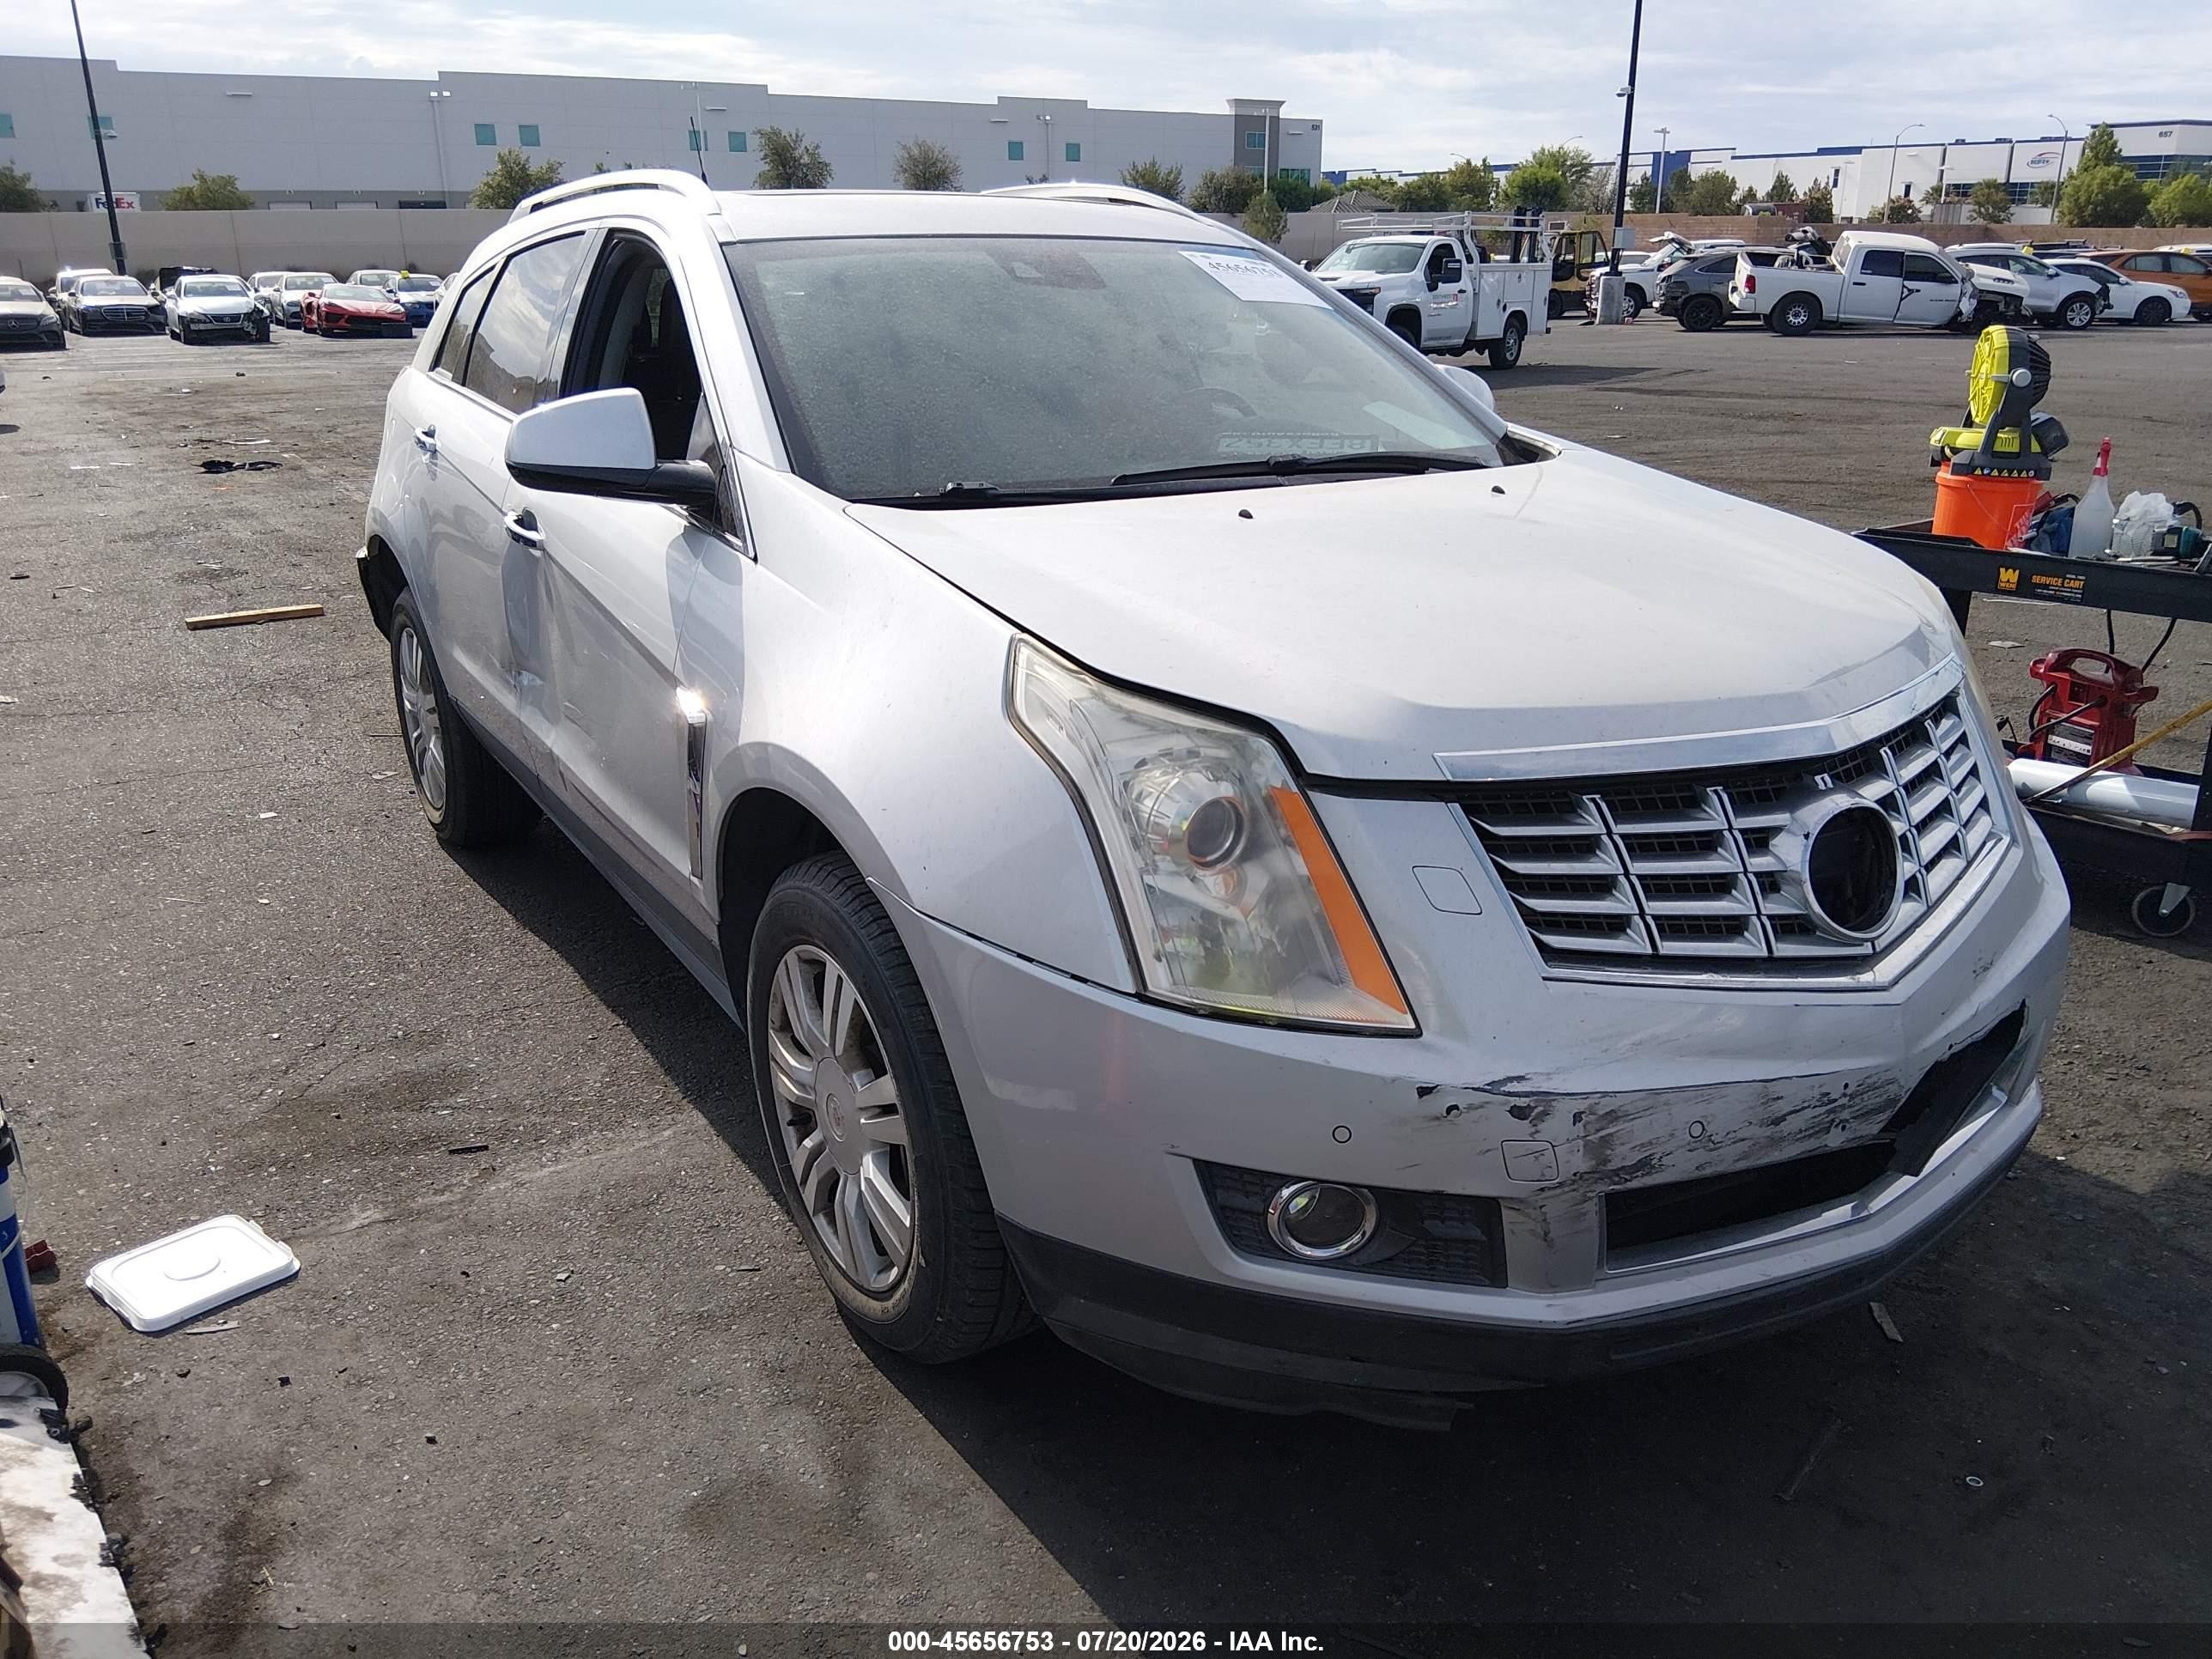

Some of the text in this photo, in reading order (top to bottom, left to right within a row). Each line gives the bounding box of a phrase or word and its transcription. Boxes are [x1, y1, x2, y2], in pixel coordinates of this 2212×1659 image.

[94, 198, 136, 210] FeEx
[1999, 581, 2017, 590] WEN
[2032, 574, 2063, 586] SERVICE
[2064, 578, 2085, 590] CART
